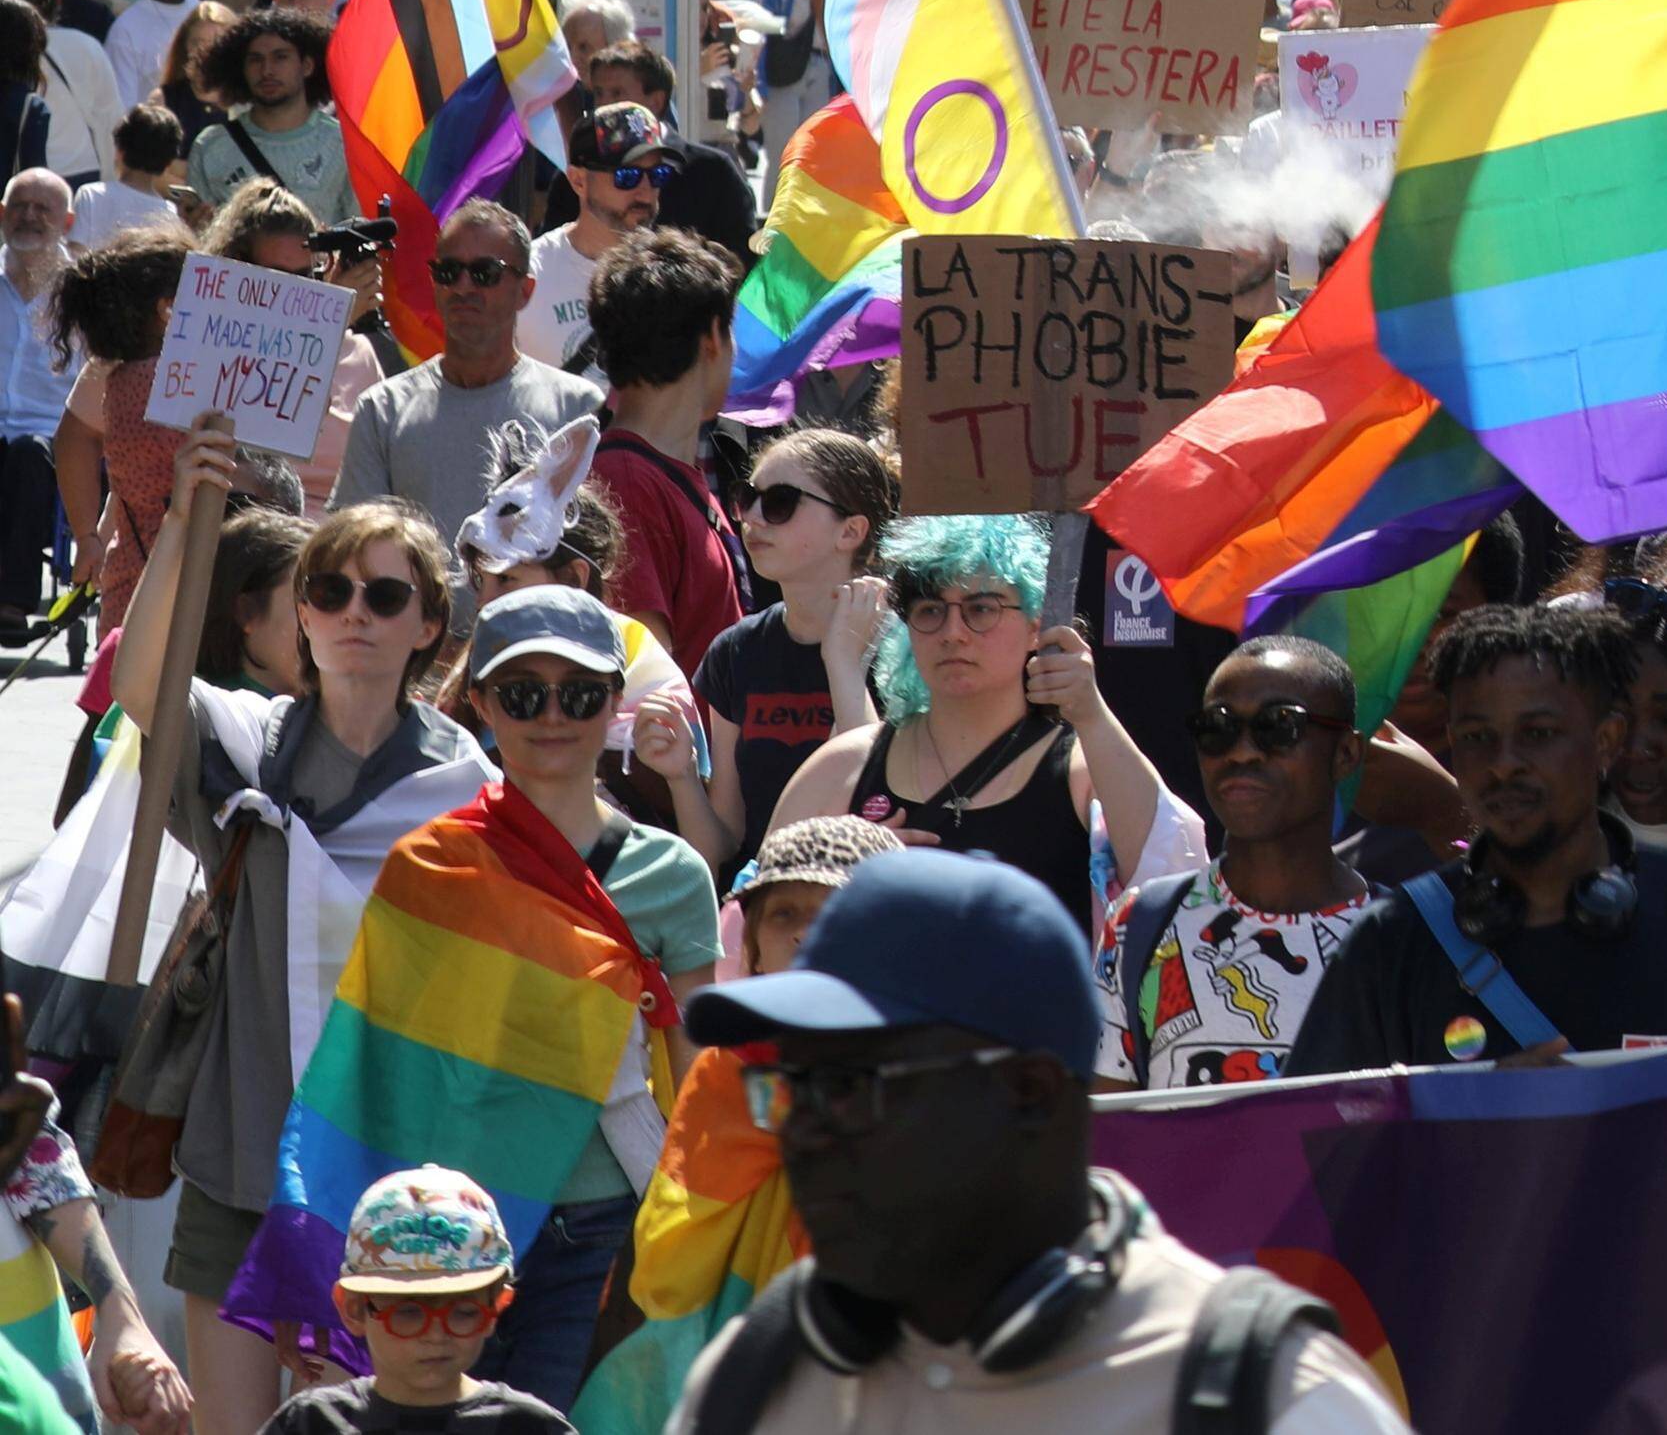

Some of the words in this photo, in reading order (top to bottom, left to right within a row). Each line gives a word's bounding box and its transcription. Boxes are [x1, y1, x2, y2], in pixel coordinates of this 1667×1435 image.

[1061, 43, 1240, 111] RESTERA
[194, 266, 230, 300] THE
[238, 277, 281, 310] ONLY
[282, 286, 346, 325] CHOICE
[912, 243, 978, 298] LA
[996, 245, 1232, 325] TRANS-
[172, 311, 192, 340] I
[202, 314, 256, 349] MADE
[258, 324, 294, 358] WAS
[299, 333, 325, 366] TO
[913, 305, 1199, 400] PHOBIE
[164, 361, 198, 399] BE
[212, 354, 321, 423] MYSELF
[928, 393, 1148, 481] TUE
[1114, 627, 1168, 642] INSOUMISE
